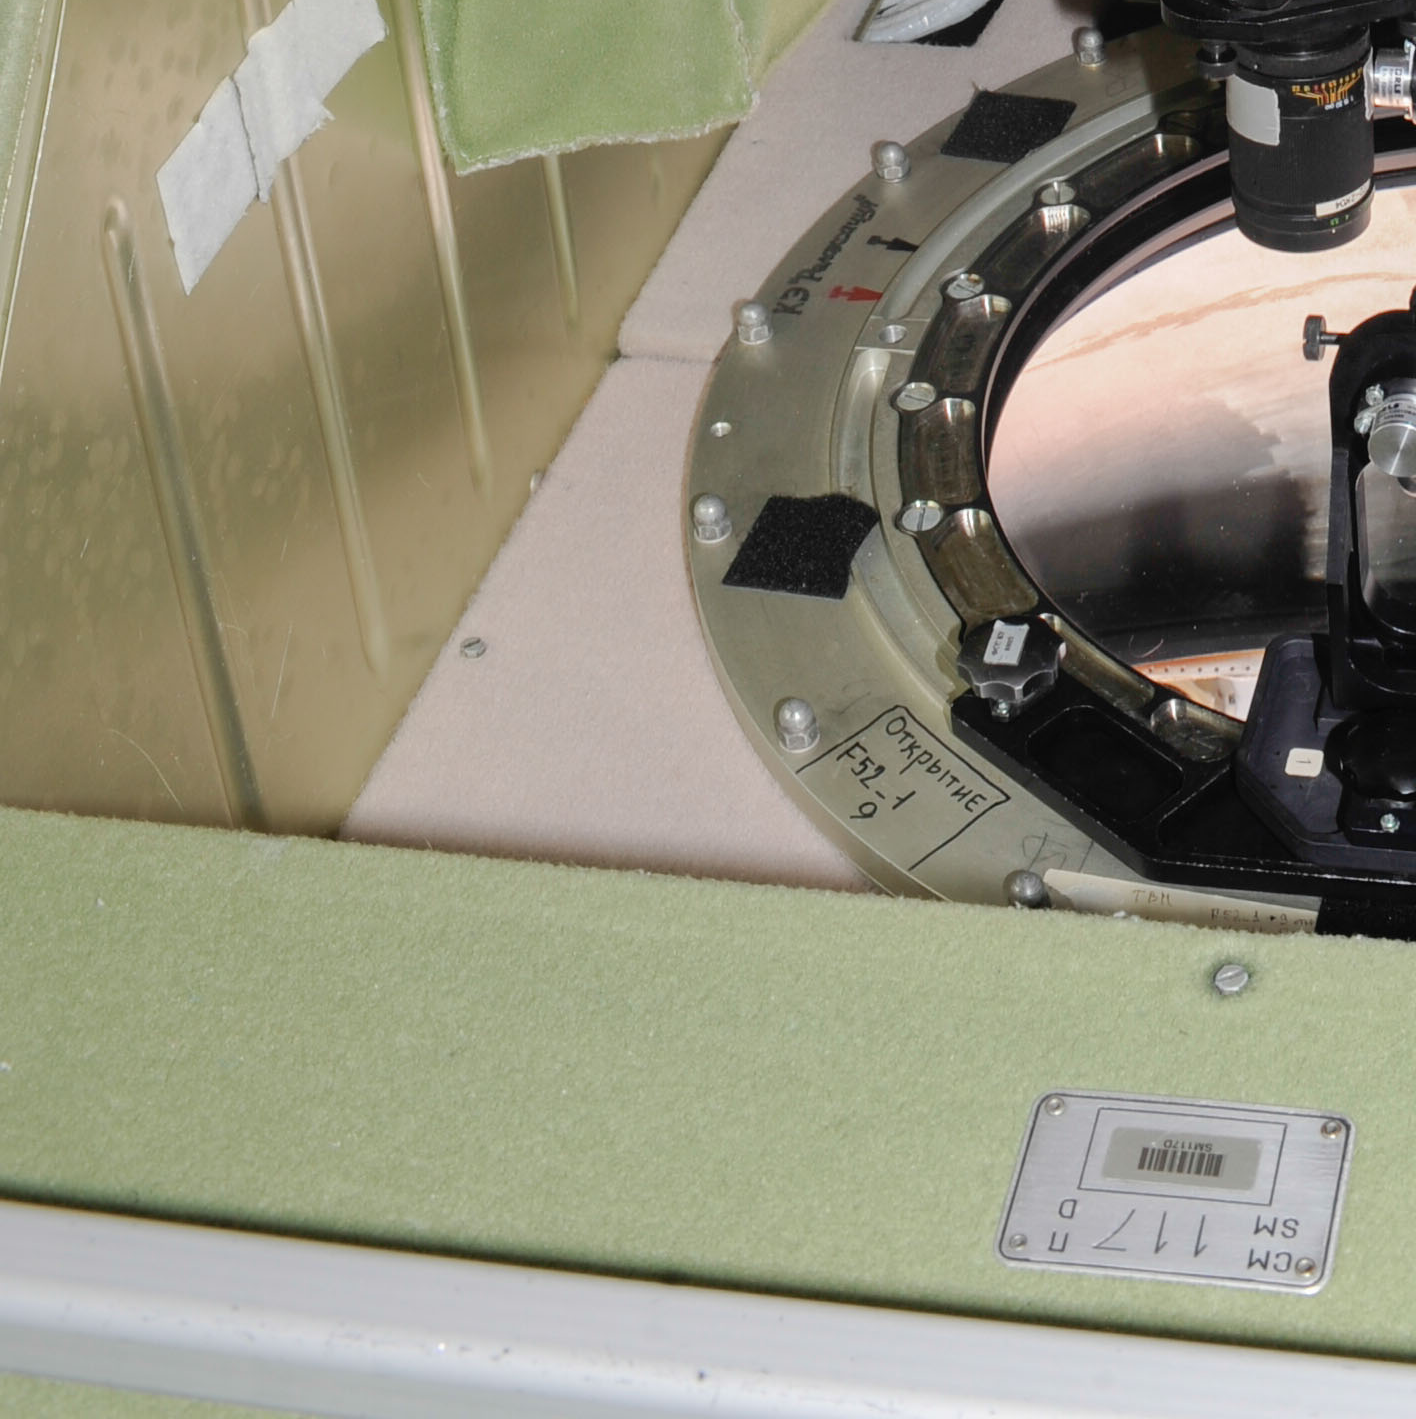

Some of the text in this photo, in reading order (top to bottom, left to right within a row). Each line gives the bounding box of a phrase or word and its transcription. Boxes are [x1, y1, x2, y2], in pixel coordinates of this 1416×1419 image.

[1163, 1139, 1213, 1152] SM117D
[1058, 1198, 1300, 1238] SM D
[1048, 1231, 1069, 1252] П
[1247, 1248, 1293, 1273] СМ
